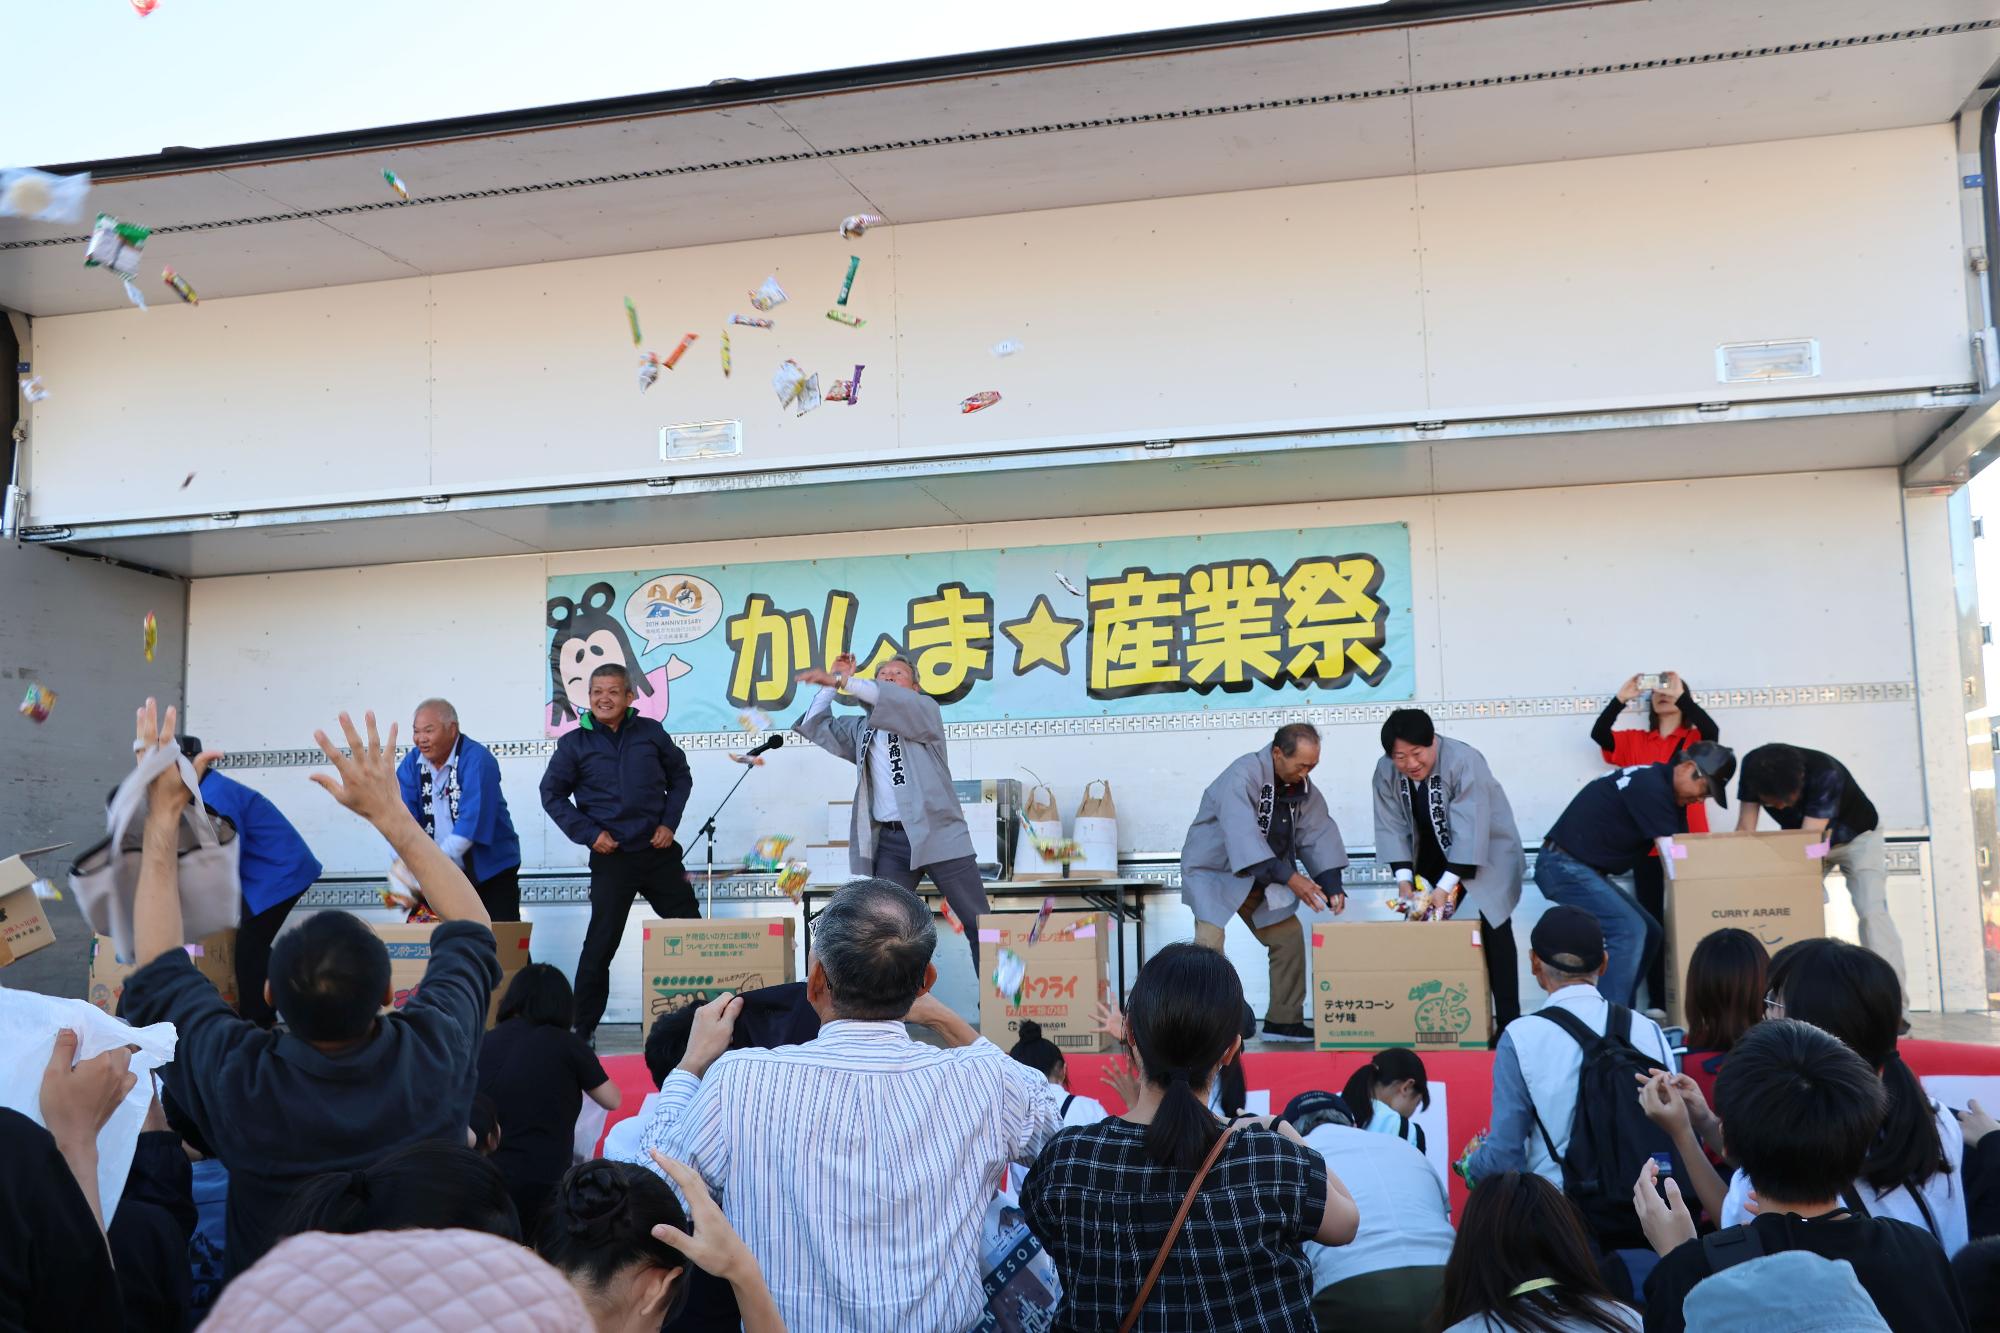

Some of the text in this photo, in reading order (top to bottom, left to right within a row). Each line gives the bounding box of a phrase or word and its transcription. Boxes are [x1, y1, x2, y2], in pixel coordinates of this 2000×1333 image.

[1257, 784, 1273, 834] 鹿島商
[1712, 907, 1791, 919] CURRY ARARE
[1324, 1000, 1395, 1011] テキサスコーン
[1324, 1013, 1357, 1023] ピザ味
